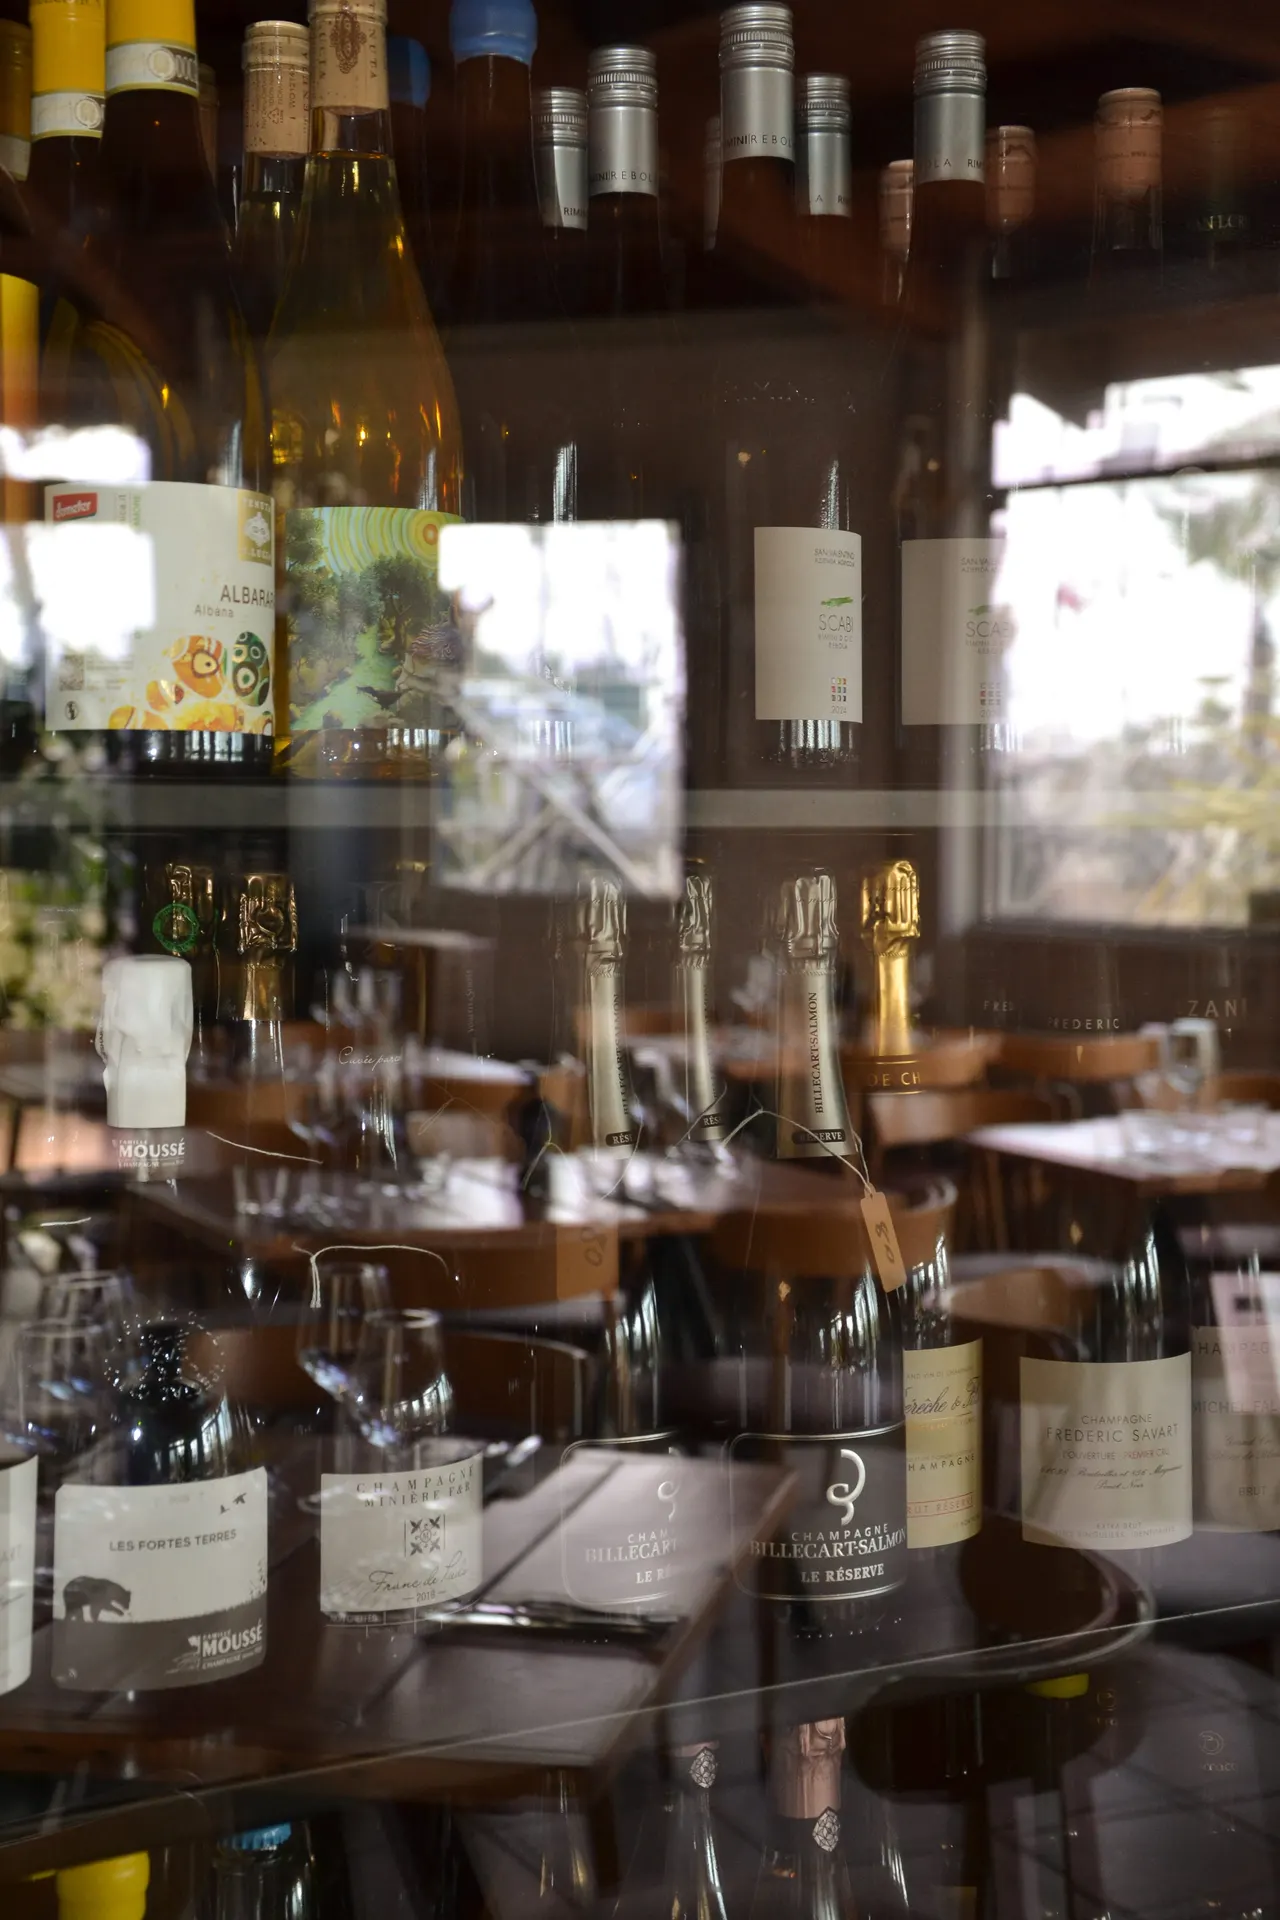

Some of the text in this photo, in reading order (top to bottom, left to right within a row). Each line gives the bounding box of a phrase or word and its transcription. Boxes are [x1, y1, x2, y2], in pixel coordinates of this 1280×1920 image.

[818, 614, 854, 633] SCABI
[808, 992, 824, 1114] BILLECART-SALMON
[119, 1138, 185, 1158] MOUSSÉ
[1081, 1414, 1153, 1425] CHAMPAGNE
[1046, 1423, 1178, 1443] FREDERIC SAVART
[357, 1464, 474, 1493] CHAMPAGNE
[364, 1489, 440, 1508] MINIÈRE
[109, 1529, 237, 1551] LES FORTES TERRES
[750, 1526, 906, 1559] BILLECART-SALMON
[791, 1523, 889, 1542] CHAMPAGNE
[636, 1570, 652, 1584] LE
[801, 1563, 885, 1583] LE RÉSERVE
[202, 1618, 263, 1657] MOUSSÉ
